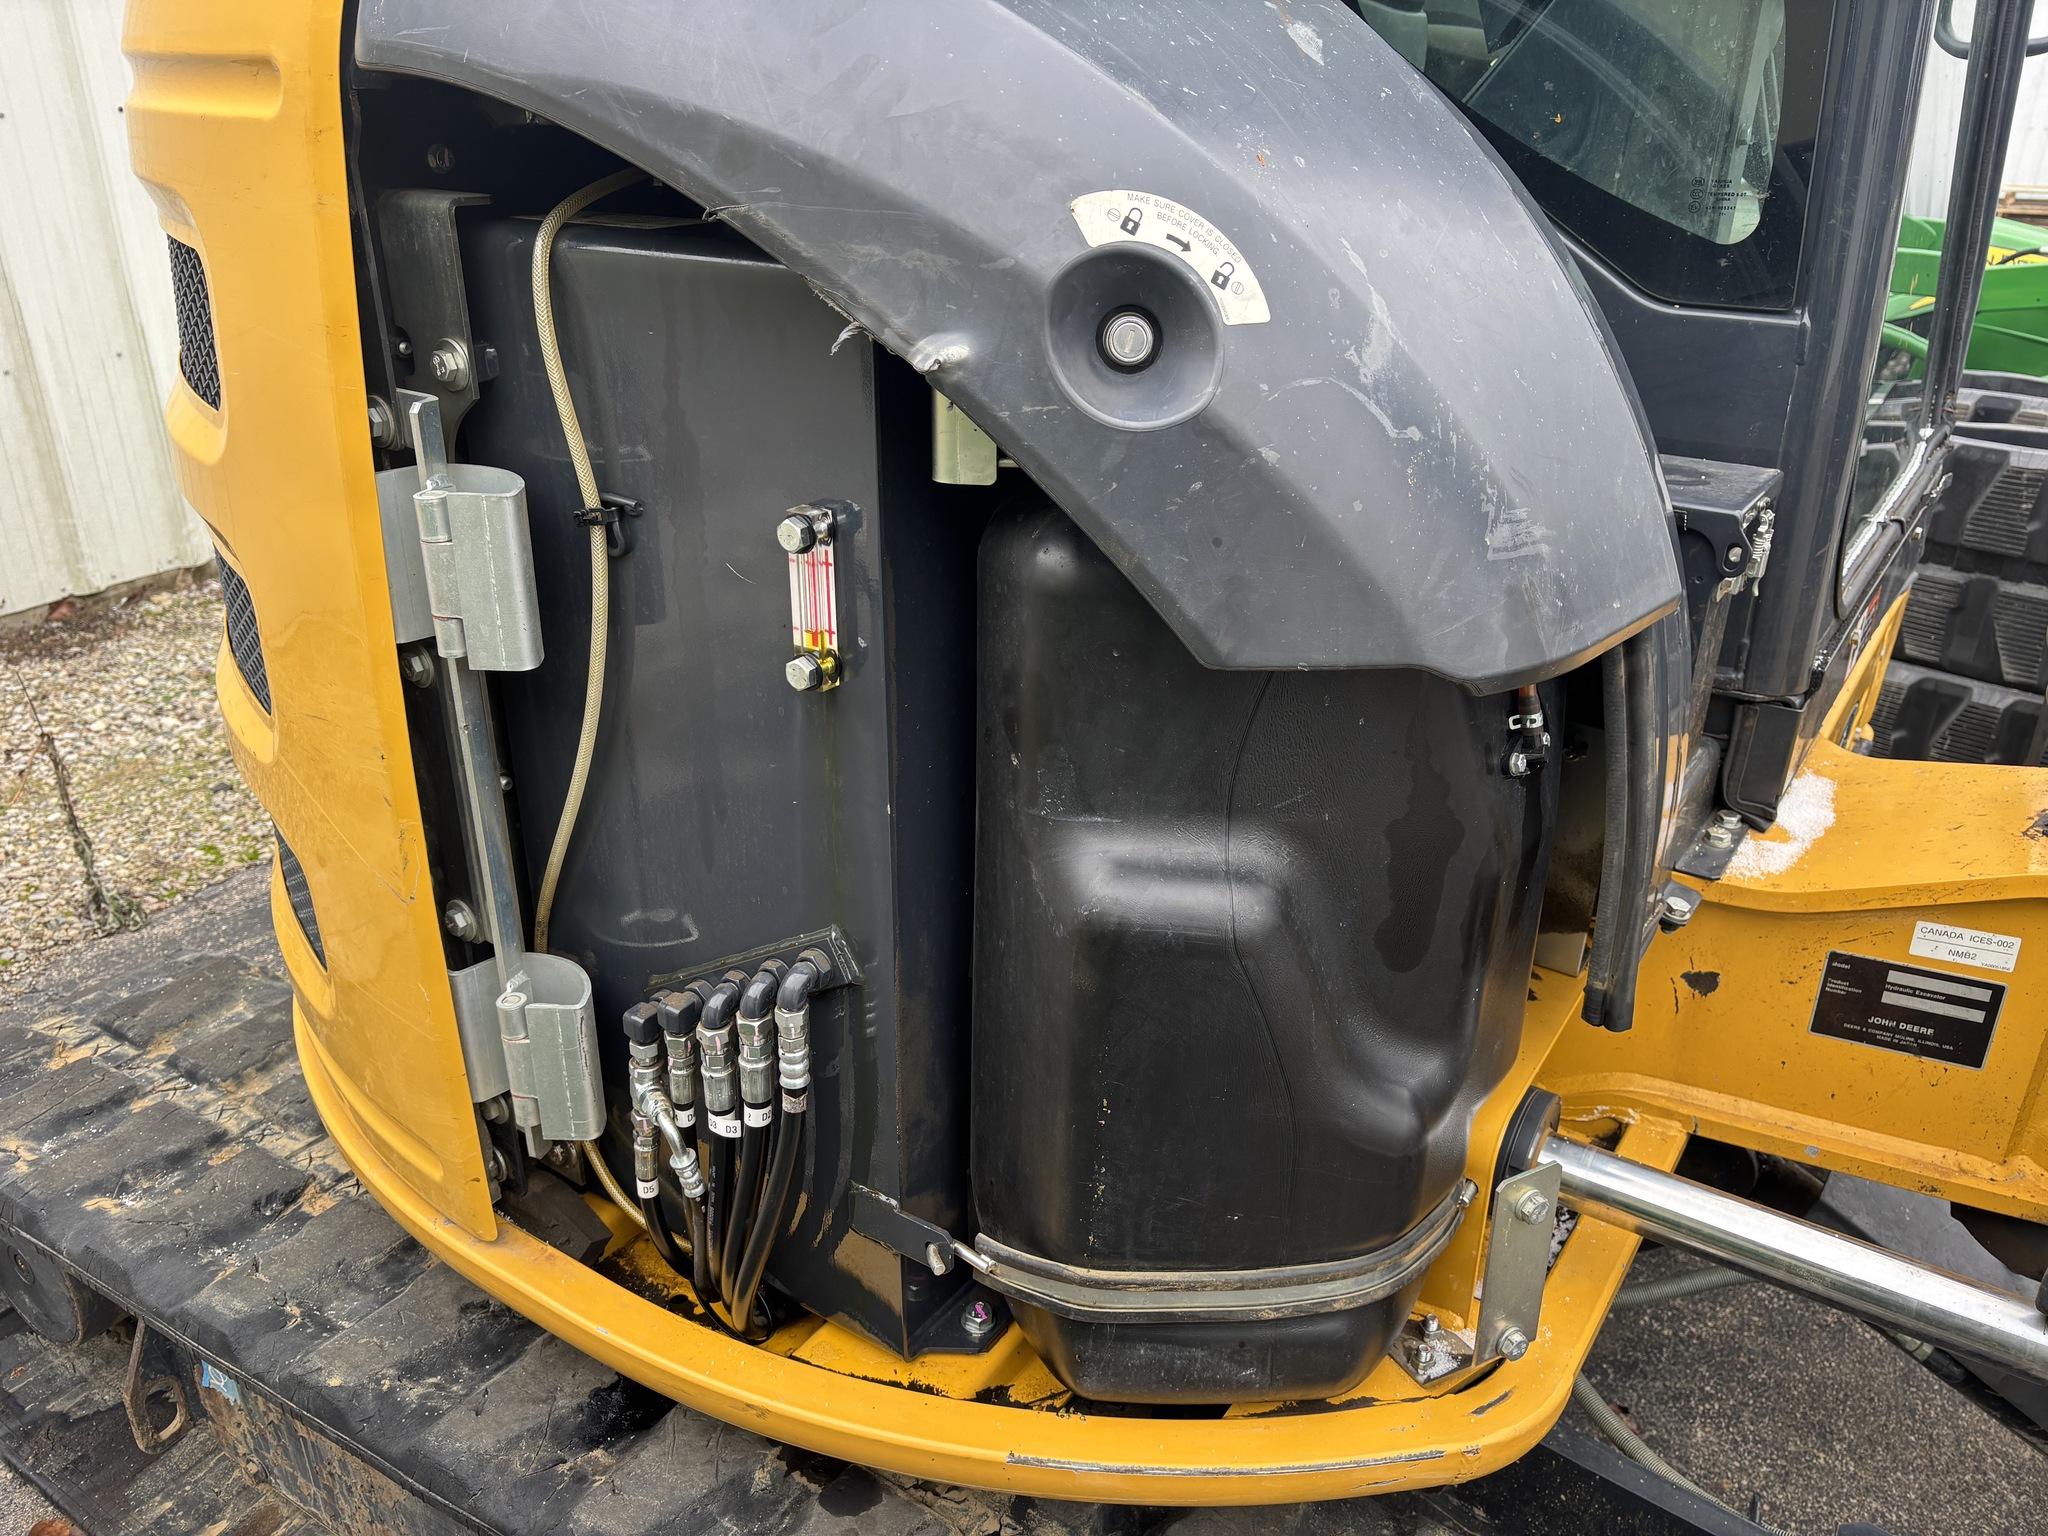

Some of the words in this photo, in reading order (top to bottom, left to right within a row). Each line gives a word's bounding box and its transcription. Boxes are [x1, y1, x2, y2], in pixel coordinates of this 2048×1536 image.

[1127, 193, 1150, 205] MAKE
[1153, 199, 1176, 214] SURE
[1178, 209, 1204, 230] COVER
[1204, 227, 1214, 237] IS
[1214, 235, 1241, 263] CLOSED
[1156, 211, 1187, 231] BEFORE
[1188, 227, 1220, 257] LOCKING.
[1920, 926, 1964, 940] CANADA
[1969, 935, 2015, 949] ICES-002
[1948, 949, 1977, 961] NMB2
[1826, 982, 1862, 994] Identification
[1827, 977, 1850, 986] Product
[1825, 986, 1847, 995] Number
[1885, 983, 1914, 994] Hydraulic
[1915, 990, 1946, 1000] Excavator
[1843, 1022, 1861, 1031] DEERE
[1867, 1028, 1894, 1037] COMPANY
[1867, 1016, 1897, 1027] JOHN
[1898, 1022, 1935, 1036] DEERE
[725, 1125, 738, 1134] D3
[643, 1185, 655, 1194] D5
